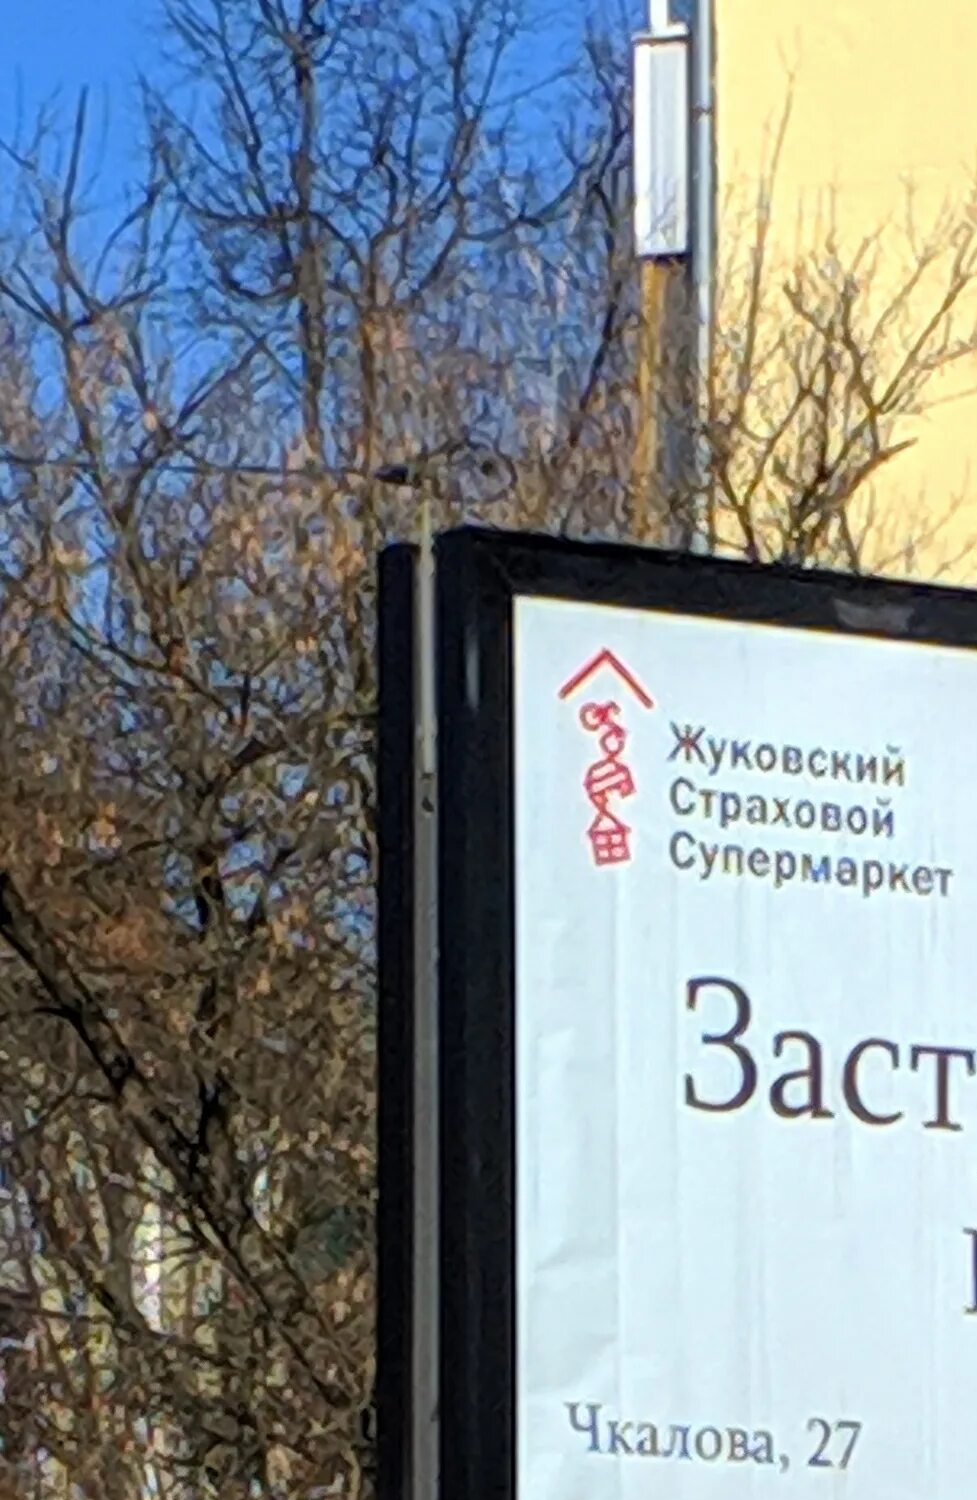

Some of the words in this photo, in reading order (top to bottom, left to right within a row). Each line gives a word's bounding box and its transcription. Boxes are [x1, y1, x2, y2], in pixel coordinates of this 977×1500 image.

[666, 721, 906, 787] Жуковский
[668, 776, 896, 840] Страховой
[668, 830, 954, 898] Супермаркет
[563, 1400, 790, 1475] Чкалова,
[805, 1416, 863, 1471] 27
